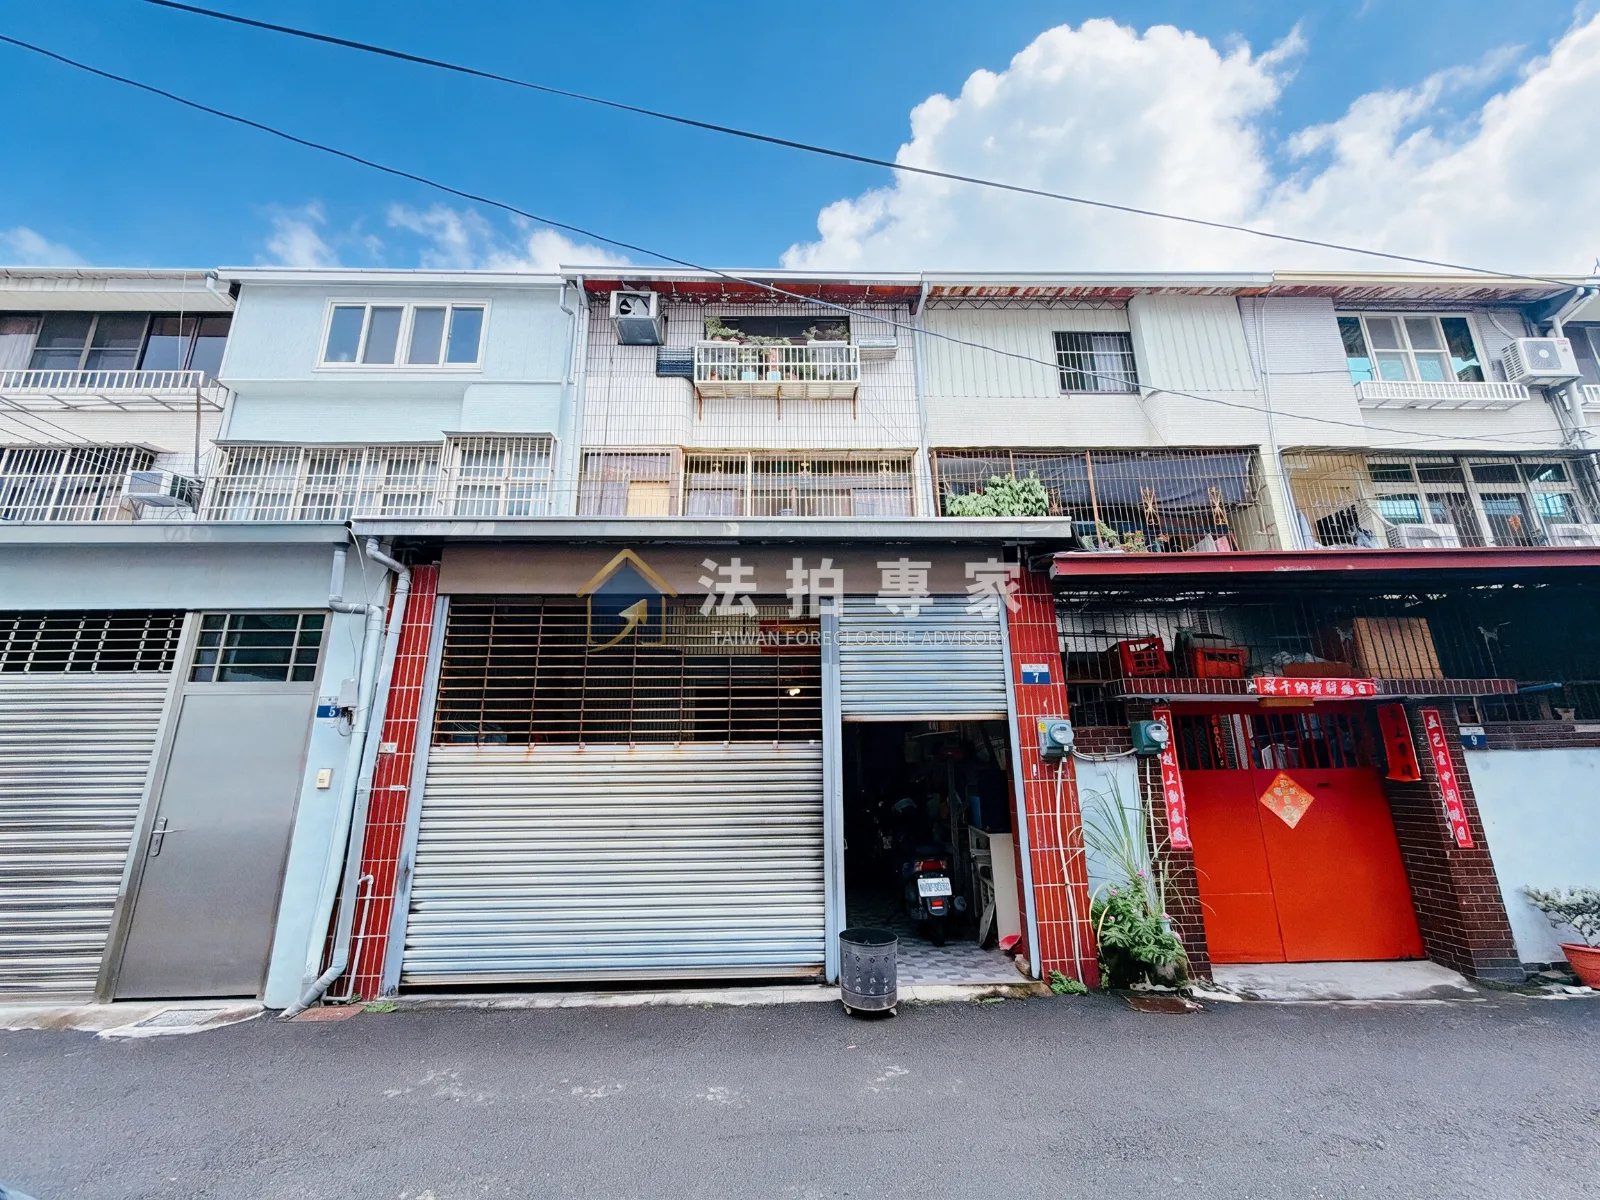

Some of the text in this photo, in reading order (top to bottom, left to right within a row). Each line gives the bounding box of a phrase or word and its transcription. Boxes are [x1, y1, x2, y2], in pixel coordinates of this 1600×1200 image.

[1033, 673, 1040, 683] 7
[328, 707, 336, 717] 5
[1471, 735, 1478, 746] 9
